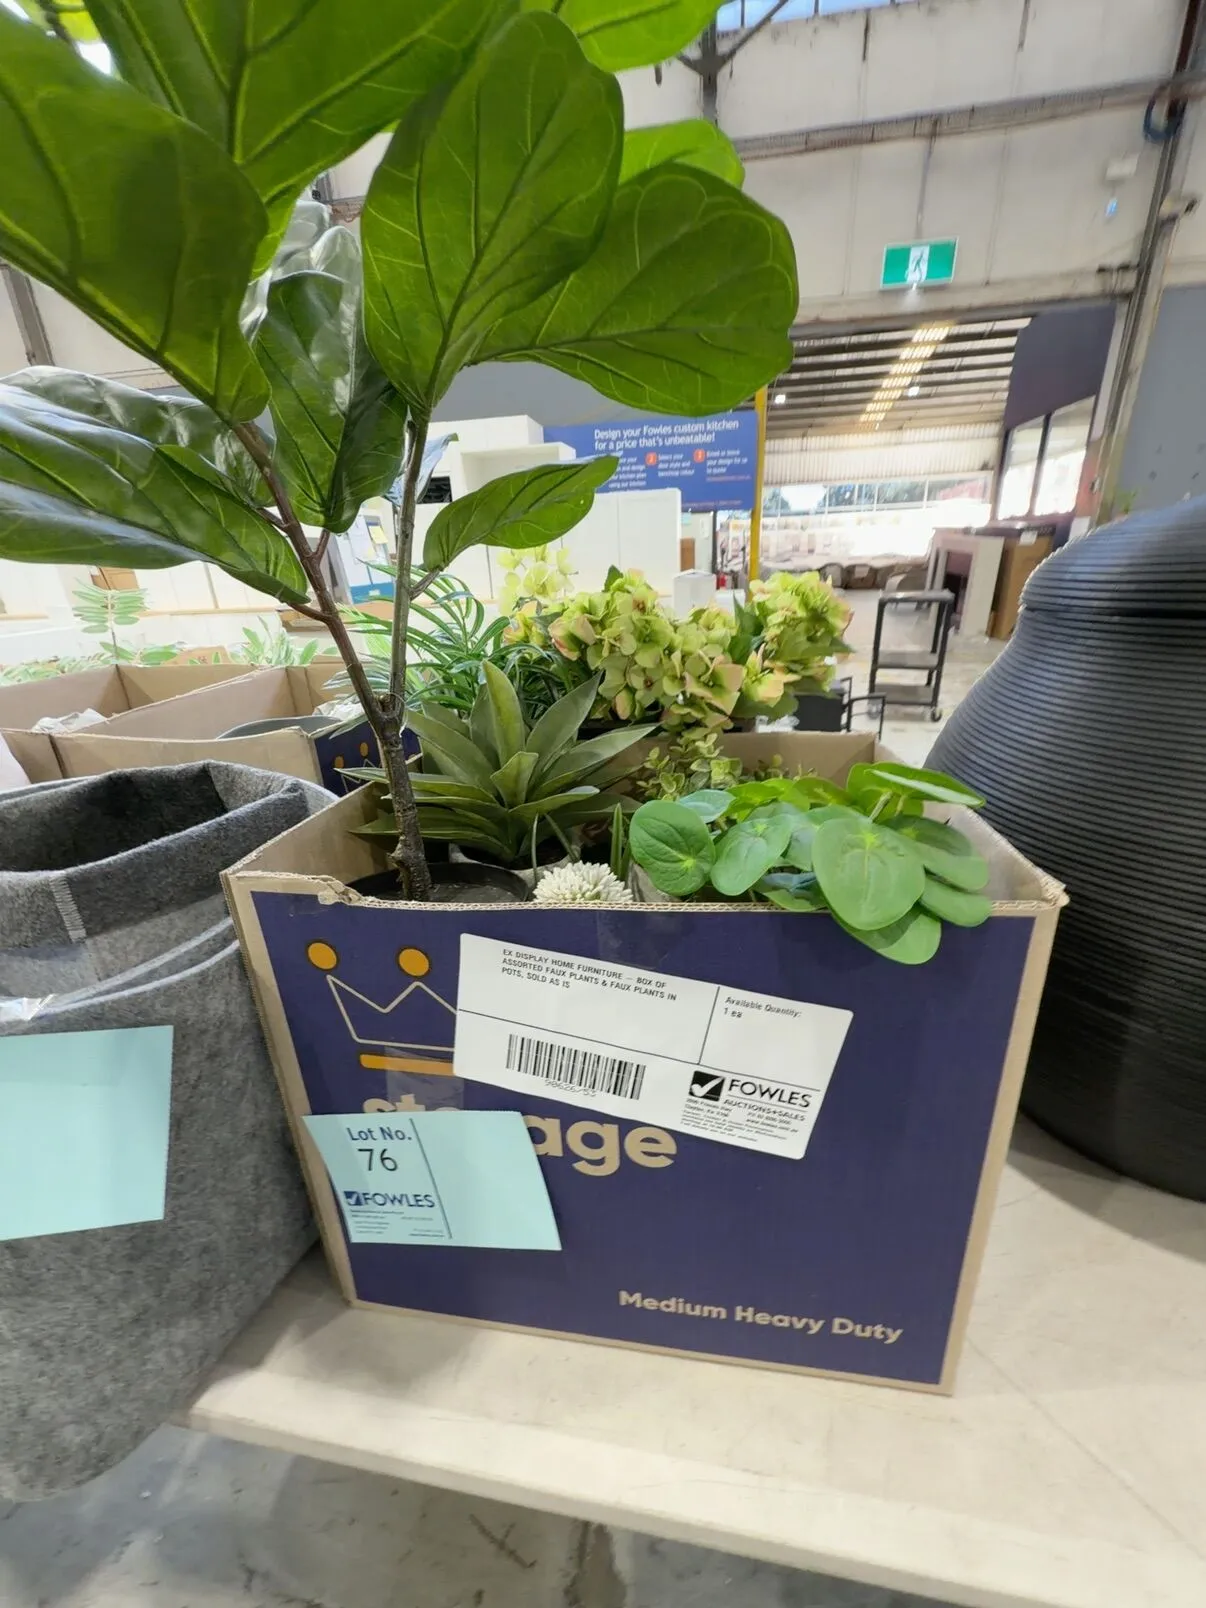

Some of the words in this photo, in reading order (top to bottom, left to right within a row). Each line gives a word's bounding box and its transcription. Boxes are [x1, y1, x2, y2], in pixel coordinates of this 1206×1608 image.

[595, 428, 621, 440] Design
[623, 428, 641, 440] your
[643, 424, 672, 436] Fowles
[674, 422, 705, 433] custom
[706, 419, 739, 431] kitchen
[595, 440, 607, 450] for
[608, 442, 614, 450] a
[616, 438, 638, 451] price
[639, 435, 663, 447] that's
[664, 432, 715, 446] unbeatable!
[502, 958, 543, 972] ASSORTED
[546, 966, 566, 977] FAUX
[569, 972, 599, 985] PLANTS
[610, 981, 631, 992] FAUX
[633, 986, 665, 999] PLANTS
[668, 993, 677, 1001] IN
[515, 952, 548, 963] DISPLAY
[551, 960, 575, 970] HOME
[577, 964, 623, 979] FURNITURE
[636, 977, 652, 986] BOX
[655, 981, 667, 989] OF
[527, 972, 547, 983] SOLD
[549, 978, 560, 986] AS
[724, 1007, 729, 1015] 1
[731, 1010, 743, 1018] ea
[725, 996, 763, 1010] Available
[728, 1079, 812, 1108] FOWLES
[347, 1127, 376, 1141] Lot
[381, 1128, 412, 1141] No.
[357, 1148, 398, 1172] 76
[362, 1192, 435, 1208] FOWLES
[619, 1290, 727, 1320] Medium
[734, 1305, 825, 1335] Heavy
[831, 1317, 904, 1344] Duty
